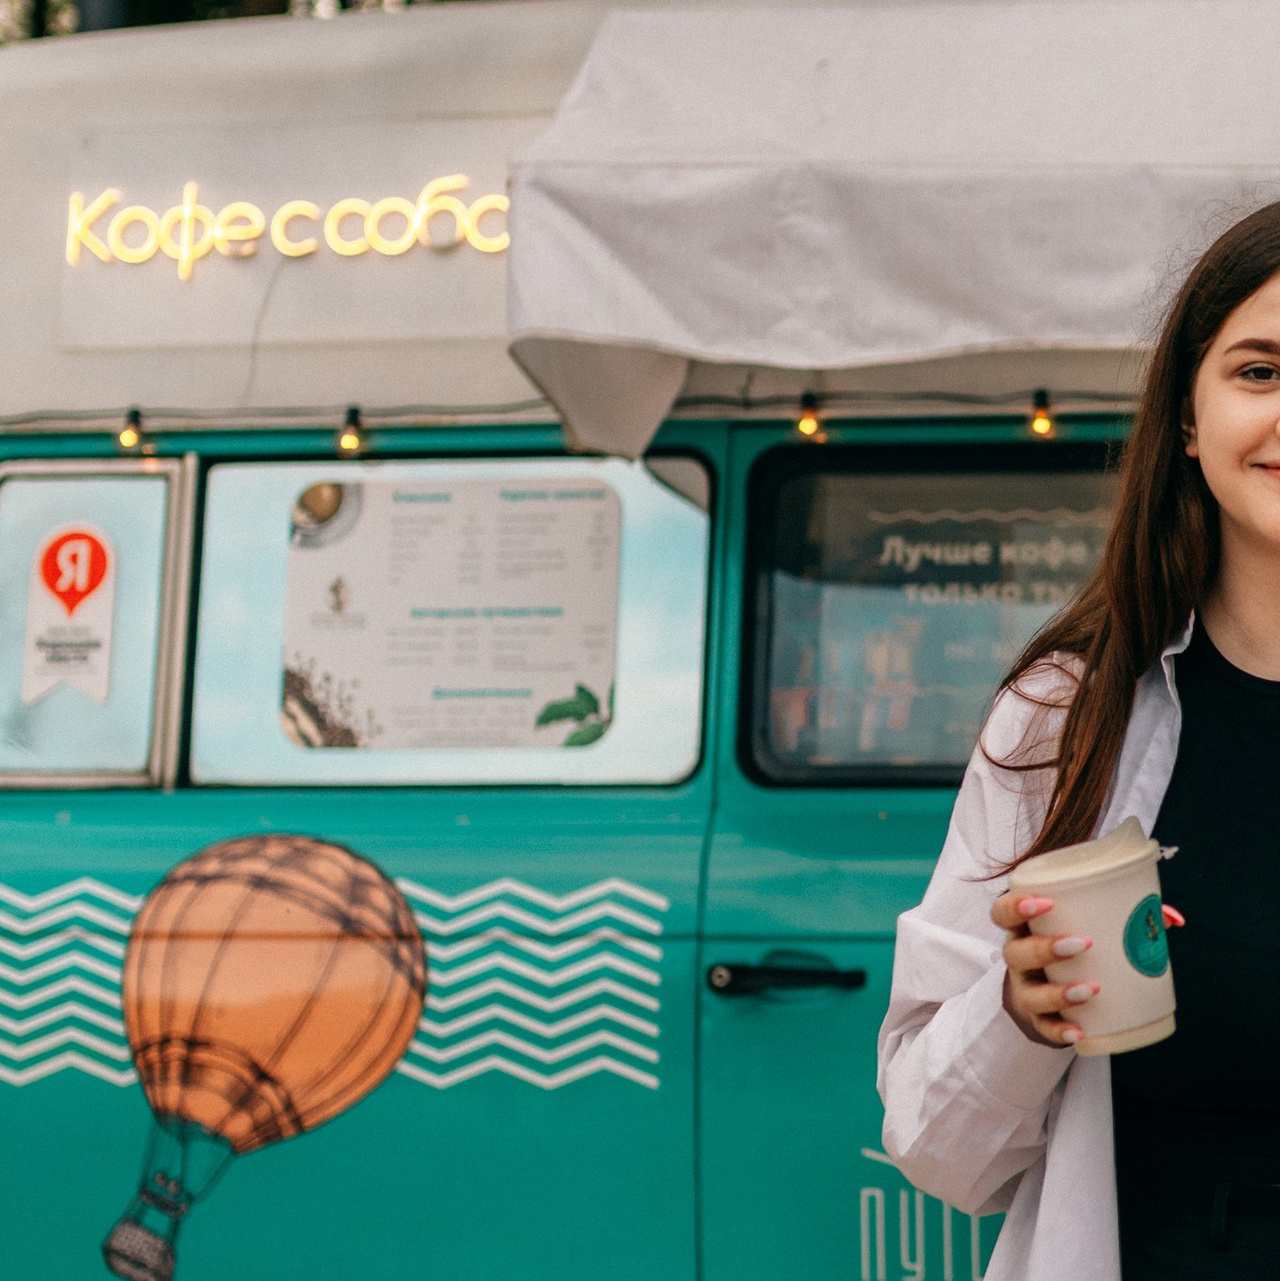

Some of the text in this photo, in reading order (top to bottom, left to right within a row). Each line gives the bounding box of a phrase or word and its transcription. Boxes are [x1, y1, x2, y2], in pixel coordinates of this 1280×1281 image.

[66, 180, 266, 280] Кофе
[270, 199, 319, 257] с
[55, 538, 92, 593] Я
[879, 535, 1087, 571] Лучше кофе
[905, 583, 1022, 605] только
